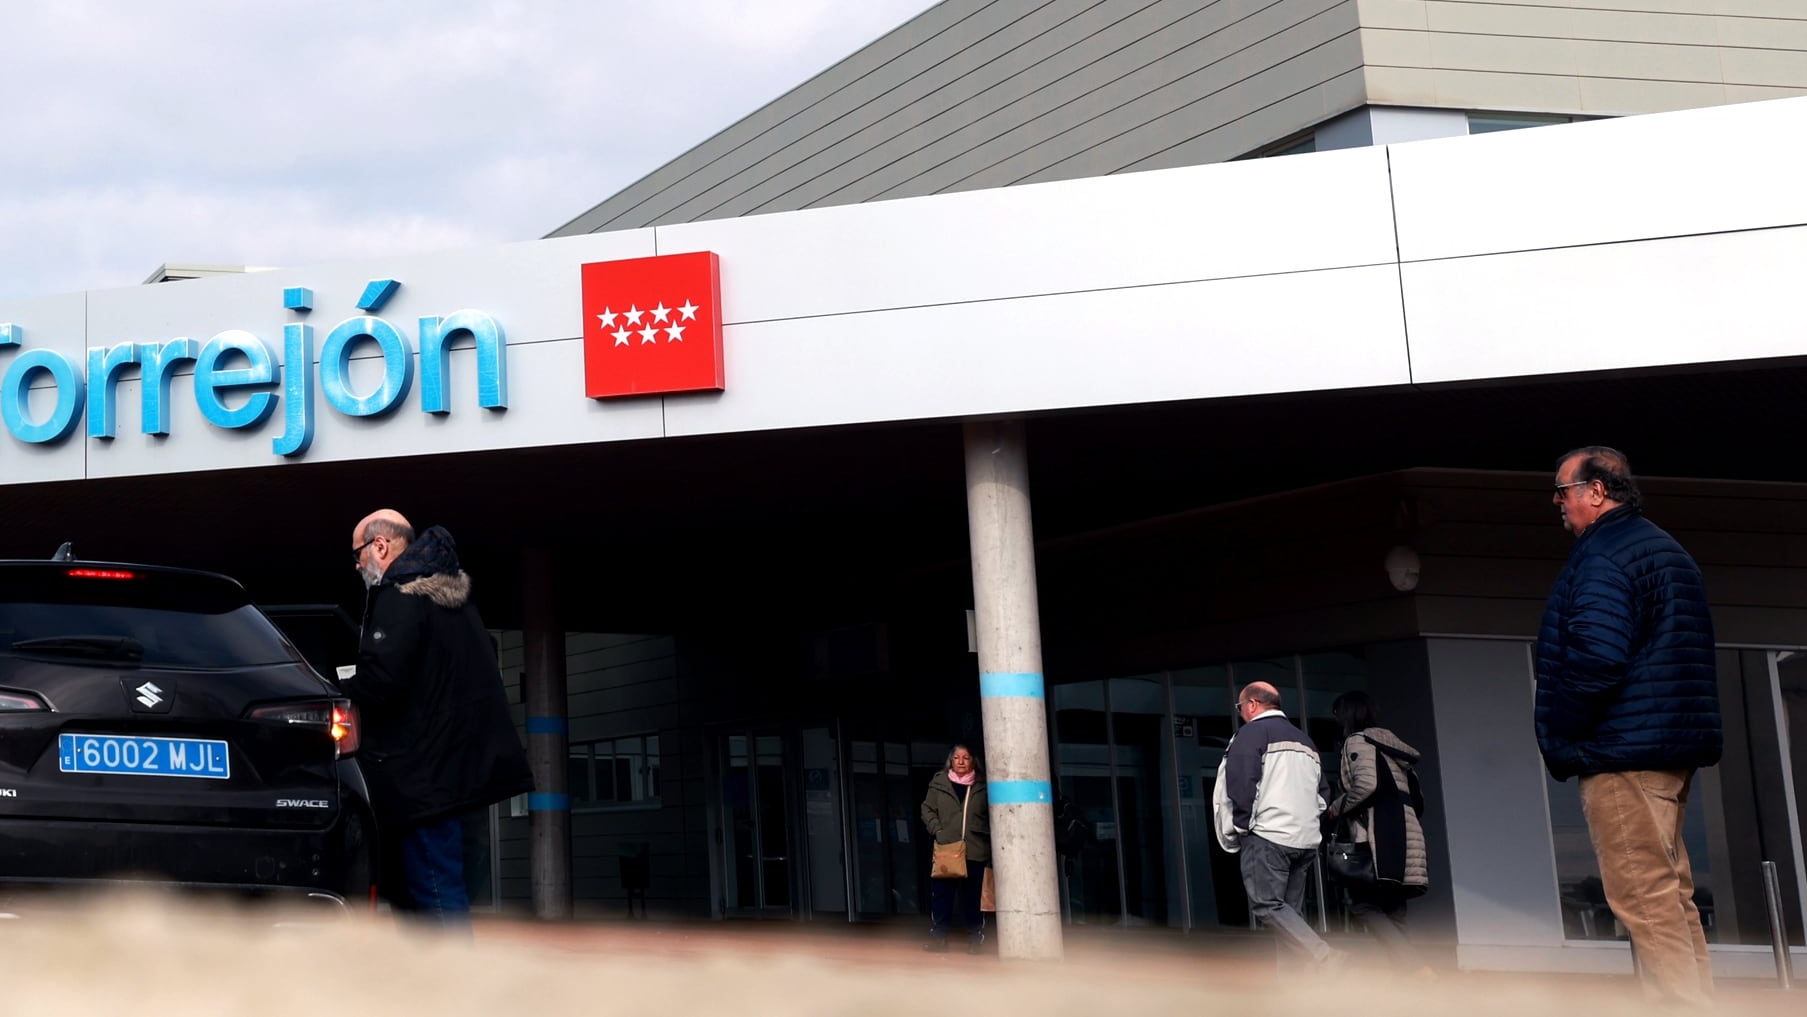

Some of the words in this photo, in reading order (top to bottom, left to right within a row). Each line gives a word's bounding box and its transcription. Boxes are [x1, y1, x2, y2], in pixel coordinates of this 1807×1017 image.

[64, 756, 71, 765] E
[83, 739, 159, 770] 6002
[169, 742, 224, 772] MJL
[275, 799, 329, 808] SWACE
